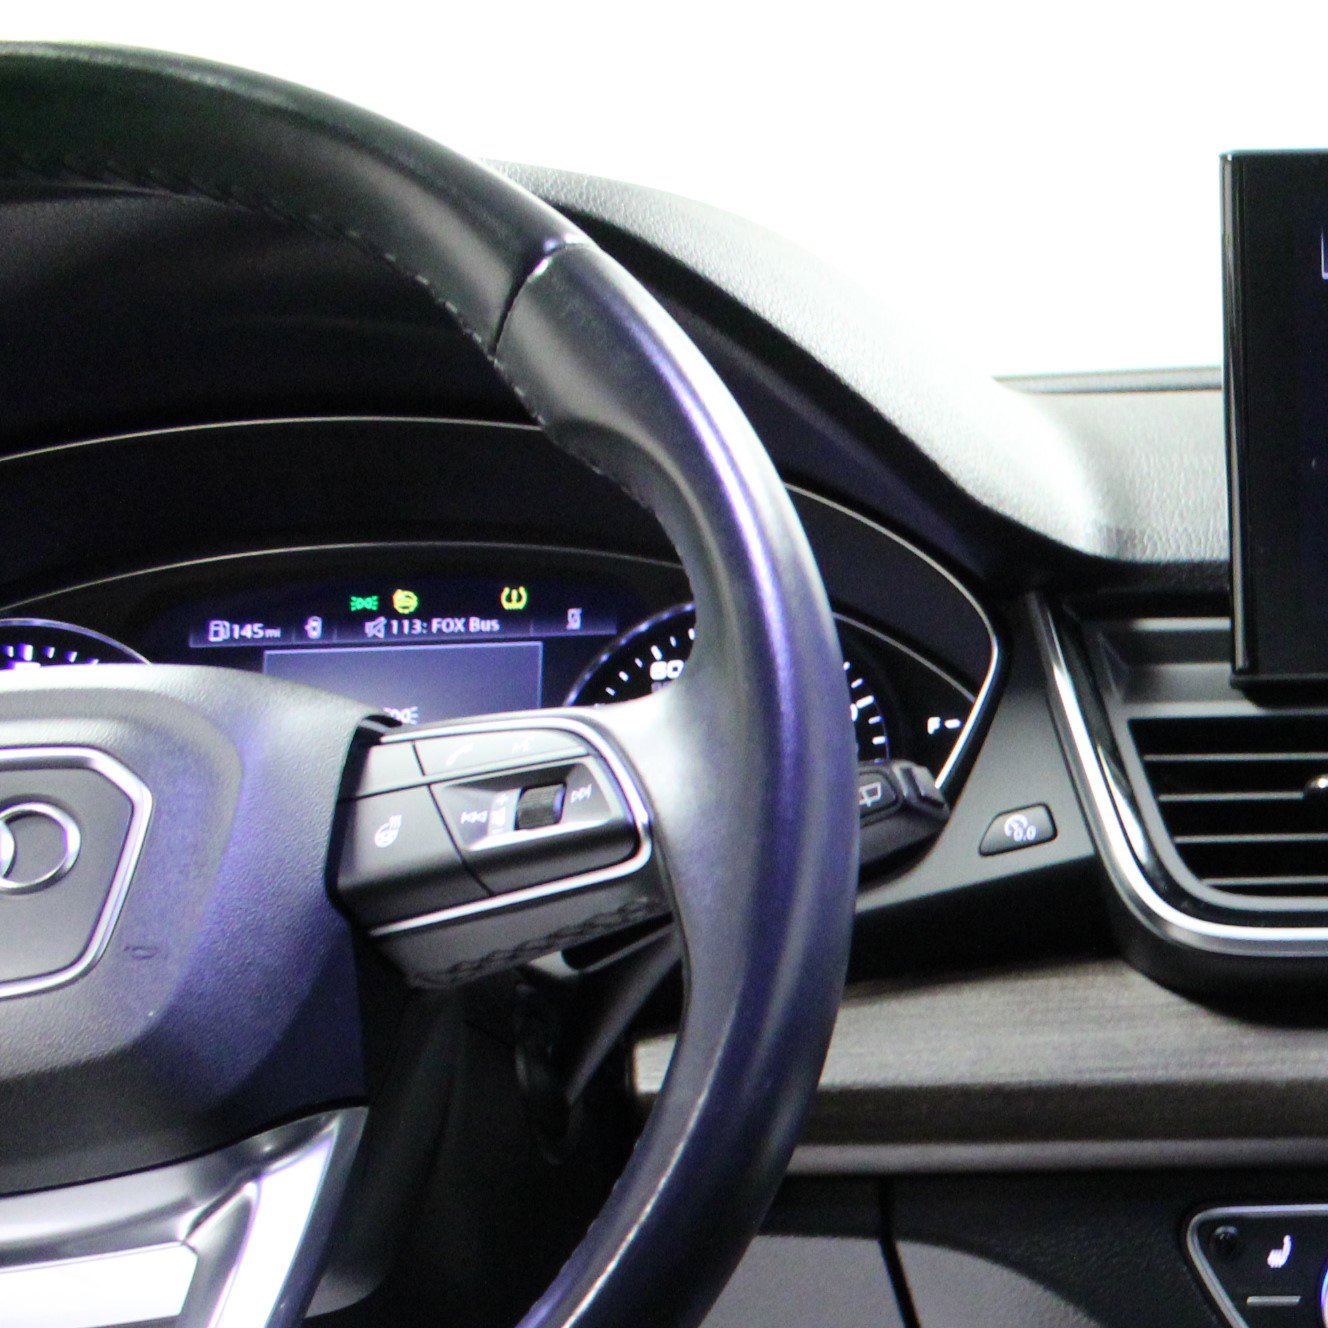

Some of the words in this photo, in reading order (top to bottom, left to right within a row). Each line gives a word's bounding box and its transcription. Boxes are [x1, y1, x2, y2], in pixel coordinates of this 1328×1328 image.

[389, 619, 428, 636] 113:
[431, 617, 466, 634] FOX
[469, 616, 501, 633] Bus
